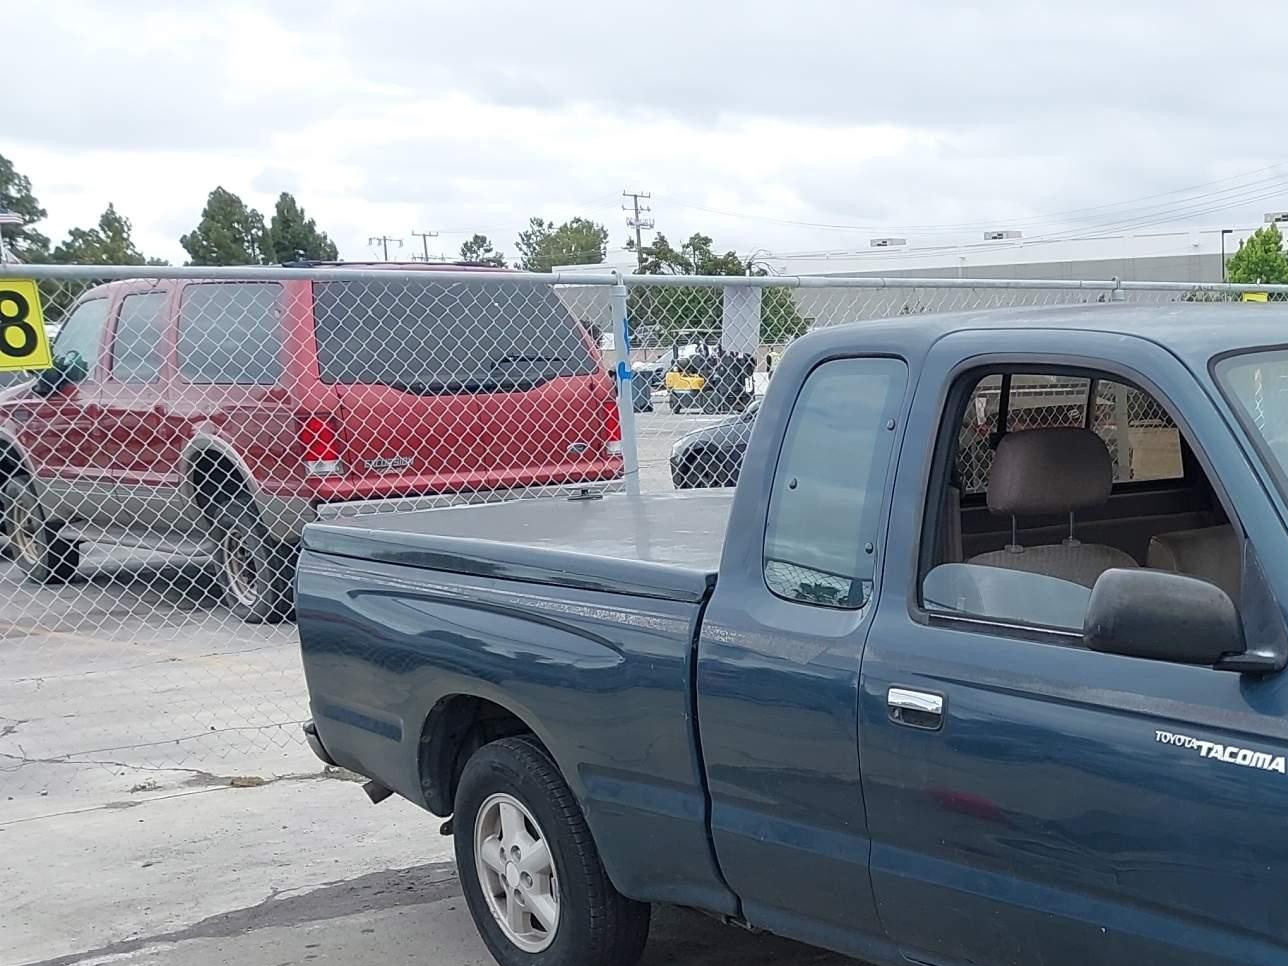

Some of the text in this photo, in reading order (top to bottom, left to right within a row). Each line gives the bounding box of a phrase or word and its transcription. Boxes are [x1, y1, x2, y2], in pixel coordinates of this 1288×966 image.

[0, 290, 38, 357] 8
[1155, 730, 1286, 774] TOYOTA TACOMA
